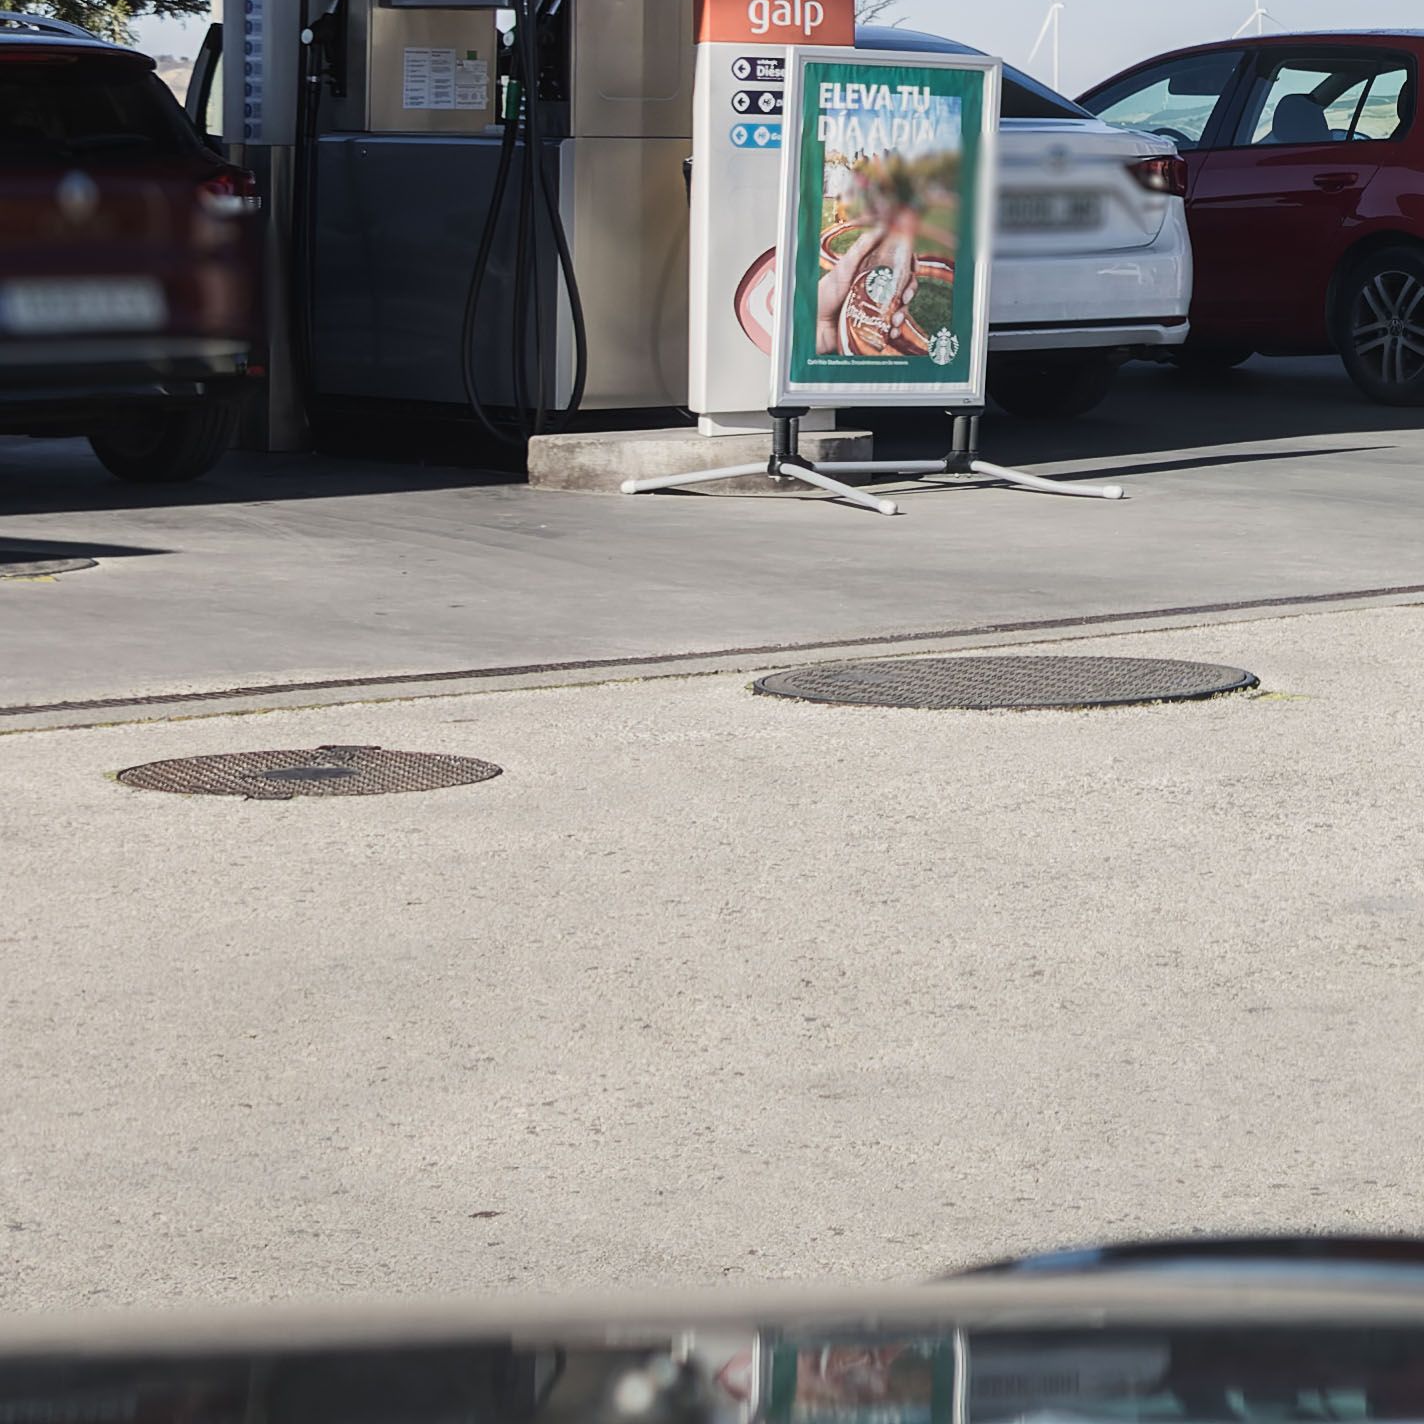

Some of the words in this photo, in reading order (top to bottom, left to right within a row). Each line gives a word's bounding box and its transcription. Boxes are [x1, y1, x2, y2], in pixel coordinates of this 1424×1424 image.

[819, 82, 894, 110] ELEVA
[896, 85, 931, 113] TU
[817, 113, 861, 145] DÍA
[866, 116, 890, 150] A
